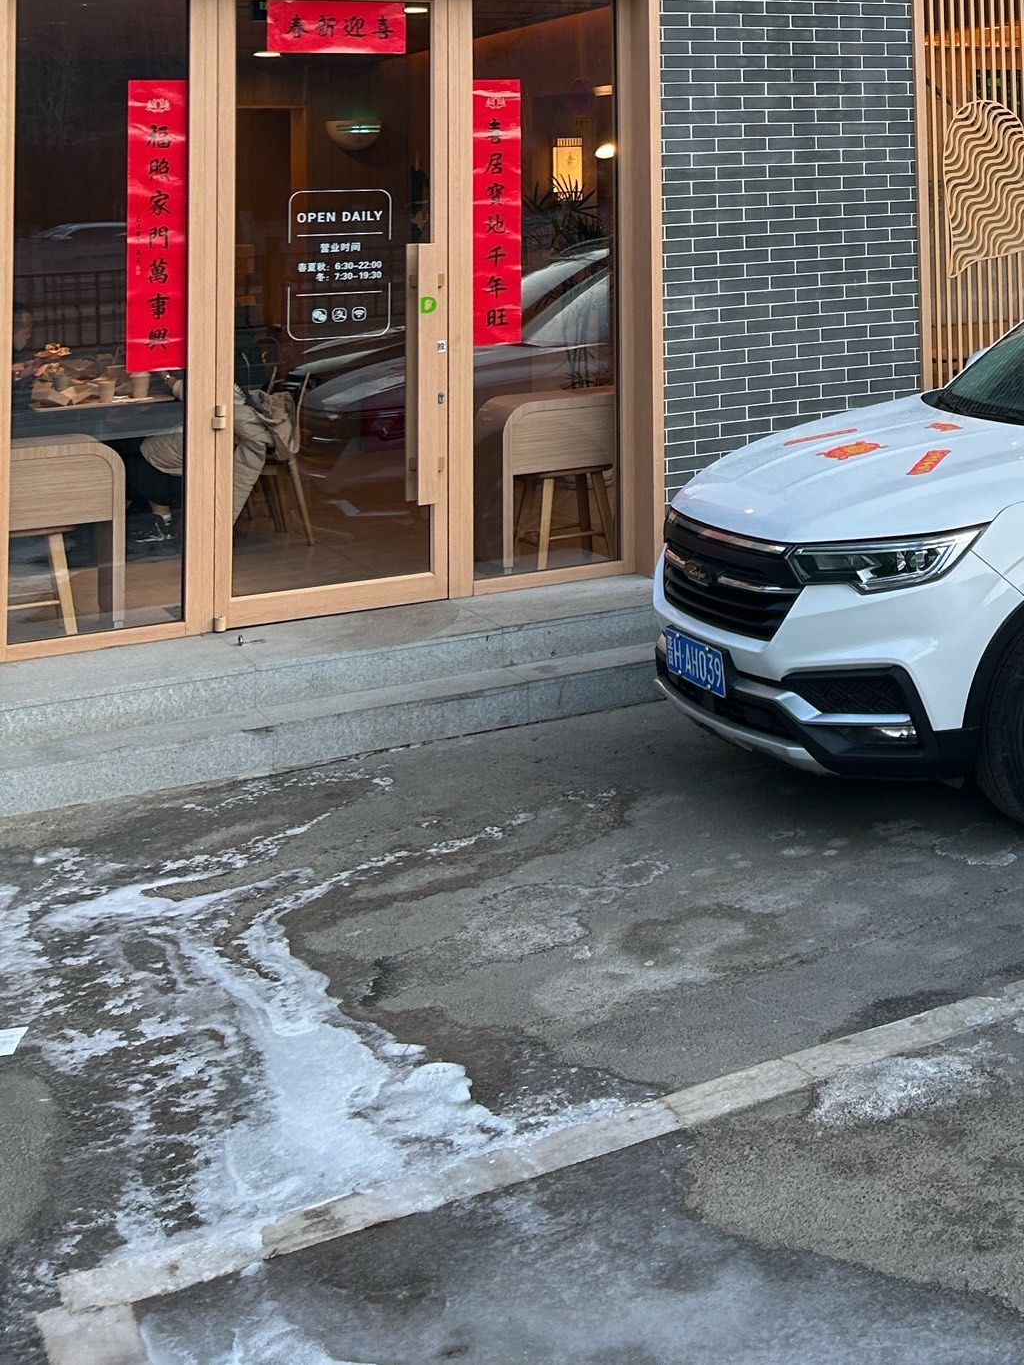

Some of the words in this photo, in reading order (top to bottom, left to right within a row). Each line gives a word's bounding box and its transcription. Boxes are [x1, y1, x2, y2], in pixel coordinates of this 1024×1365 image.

[296, 212, 336, 223] OPEN
[341, 210, 383, 222] DAILY
[320, 242, 361, 253] 营业时间
